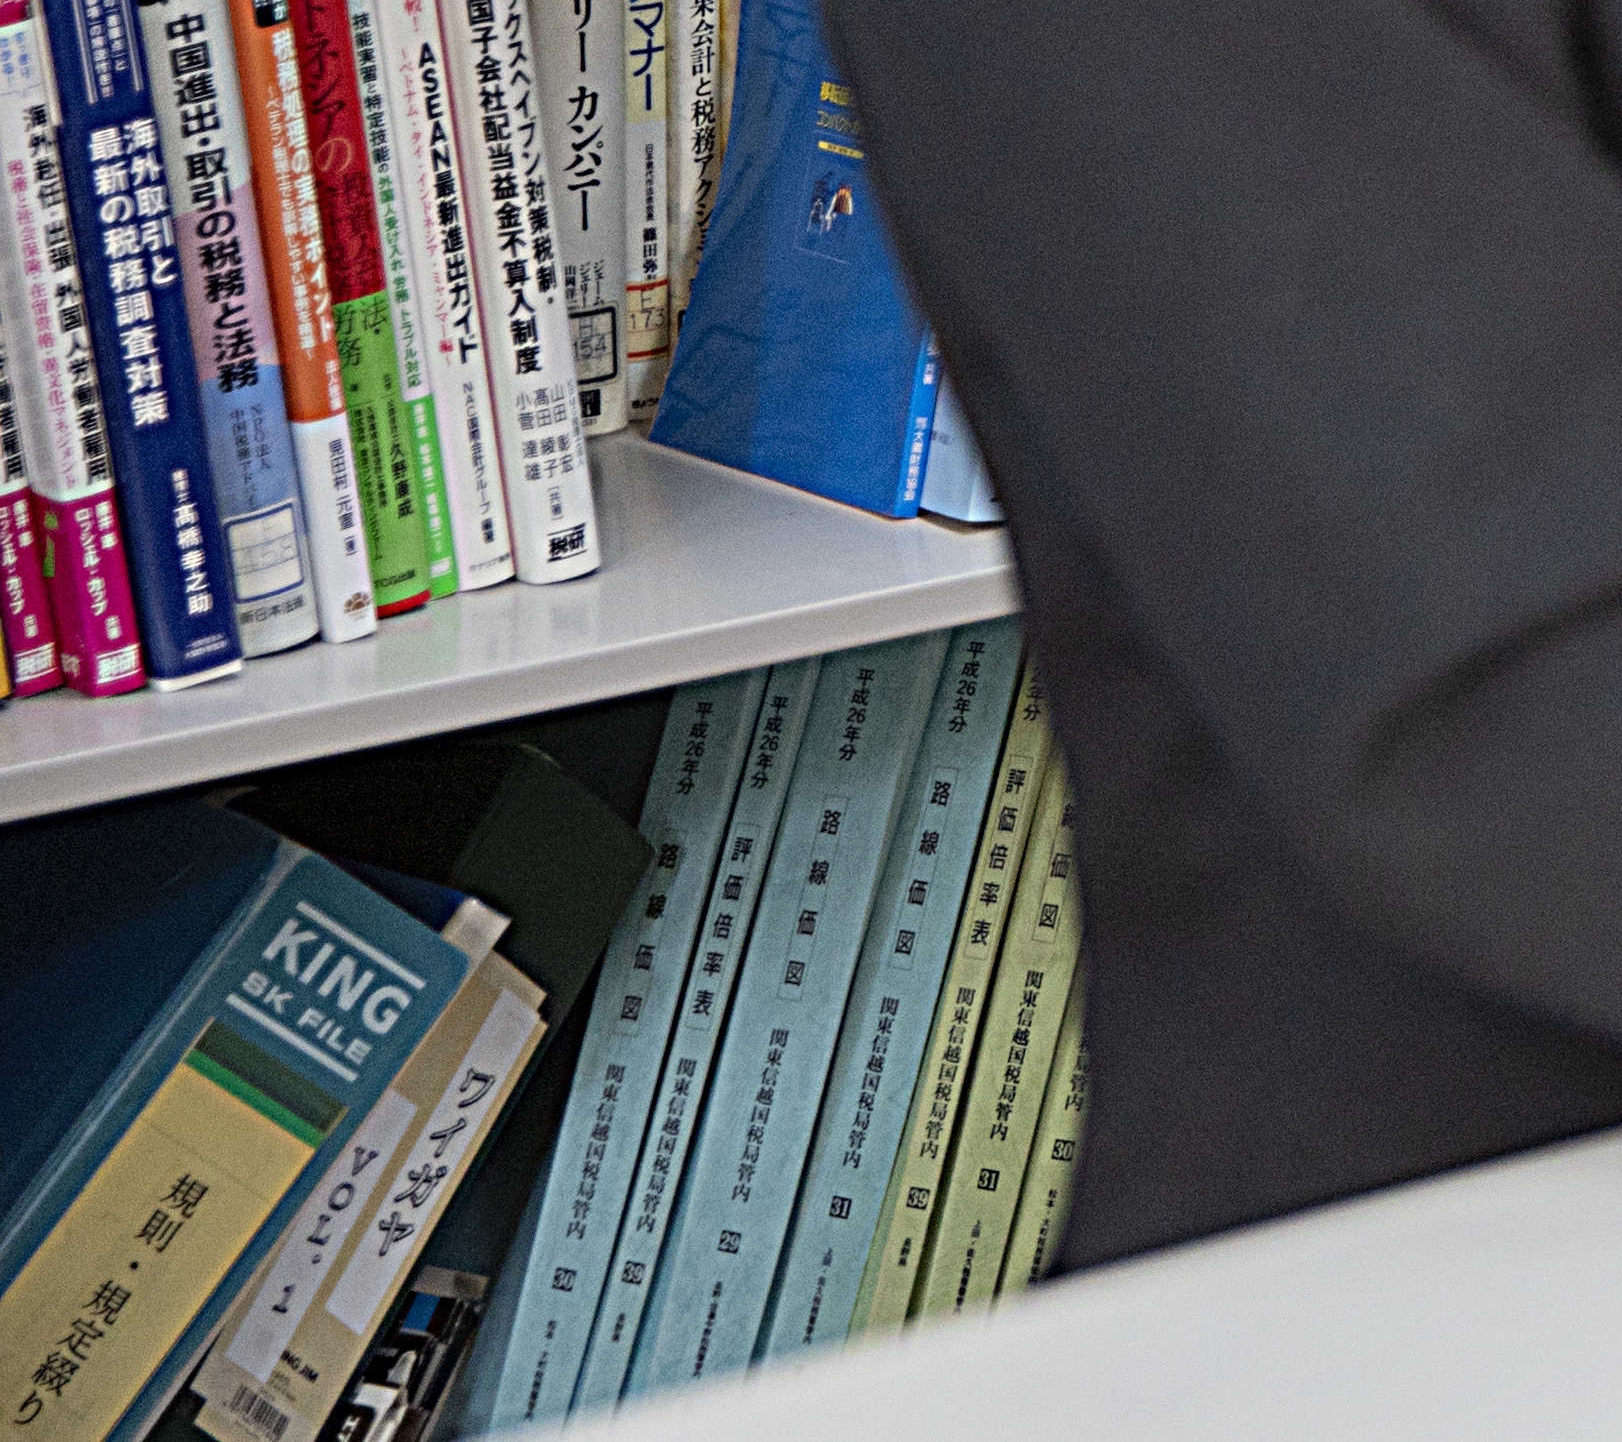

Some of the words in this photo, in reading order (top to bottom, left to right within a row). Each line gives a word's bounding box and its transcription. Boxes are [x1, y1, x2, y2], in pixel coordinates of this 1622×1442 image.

[122, 117, 178, 285] 海外取引と
[164, 13, 260, 396] 中国進出・取引の税務と法務
[417, 41, 479, 366] ASEAN最新進出ガイド
[561, 83, 604, 233] カンパニー
[87, 125, 169, 427] 最新の税務調査対策
[550, 384, 568, 424] 山田
[548, 529, 588, 557] 税研
[674, 698, 715, 797] 平成26年分
[748, 693, 790, 792] 平成26年分
[837, 666, 876, 764] 平成26年分
[947, 640, 987, 735] 平成26年分
[619, 840, 680, 1024] 路線価図
[689, 835, 755, 1020] 評価倍率表
[783, 808, 843, 988] 路線価図
[893, 780, 954, 957] 路線価図
[969, 767, 1030, 948] 評価倍率表
[241, 969, 291, 1014] SK
[296, 1006, 375, 1066] FILE
[261, 915, 413, 1037] KING
[989, 969, 1046, 1144] 関東信越国税局管内
[565, 1062, 627, 1242] 関東信越国税局管内
[636, 1056, 699, 1237] 関東信越国税局管内
[730, 1028, 790, 1205] 関東信越国税局管内
[841, 996, 901, 1170] 関東信越国税局管内
[917, 986, 977, 1160] 関東信越国税局管内
[1050, 1138, 1074, 1162] 30
[378, 1066, 499, 1260] ワイガヤ
[716, 1230, 742, 1255] 29
[828, 1195, 853, 1219] 31
[906, 1186, 931, 1210] 39
[976, 1167, 998, 1191] 31
[12, 1173, 211, 1428] 規則・規定綴り
[551, 1267, 578, 1293] 30
[621, 1260, 647, 1287] 39
